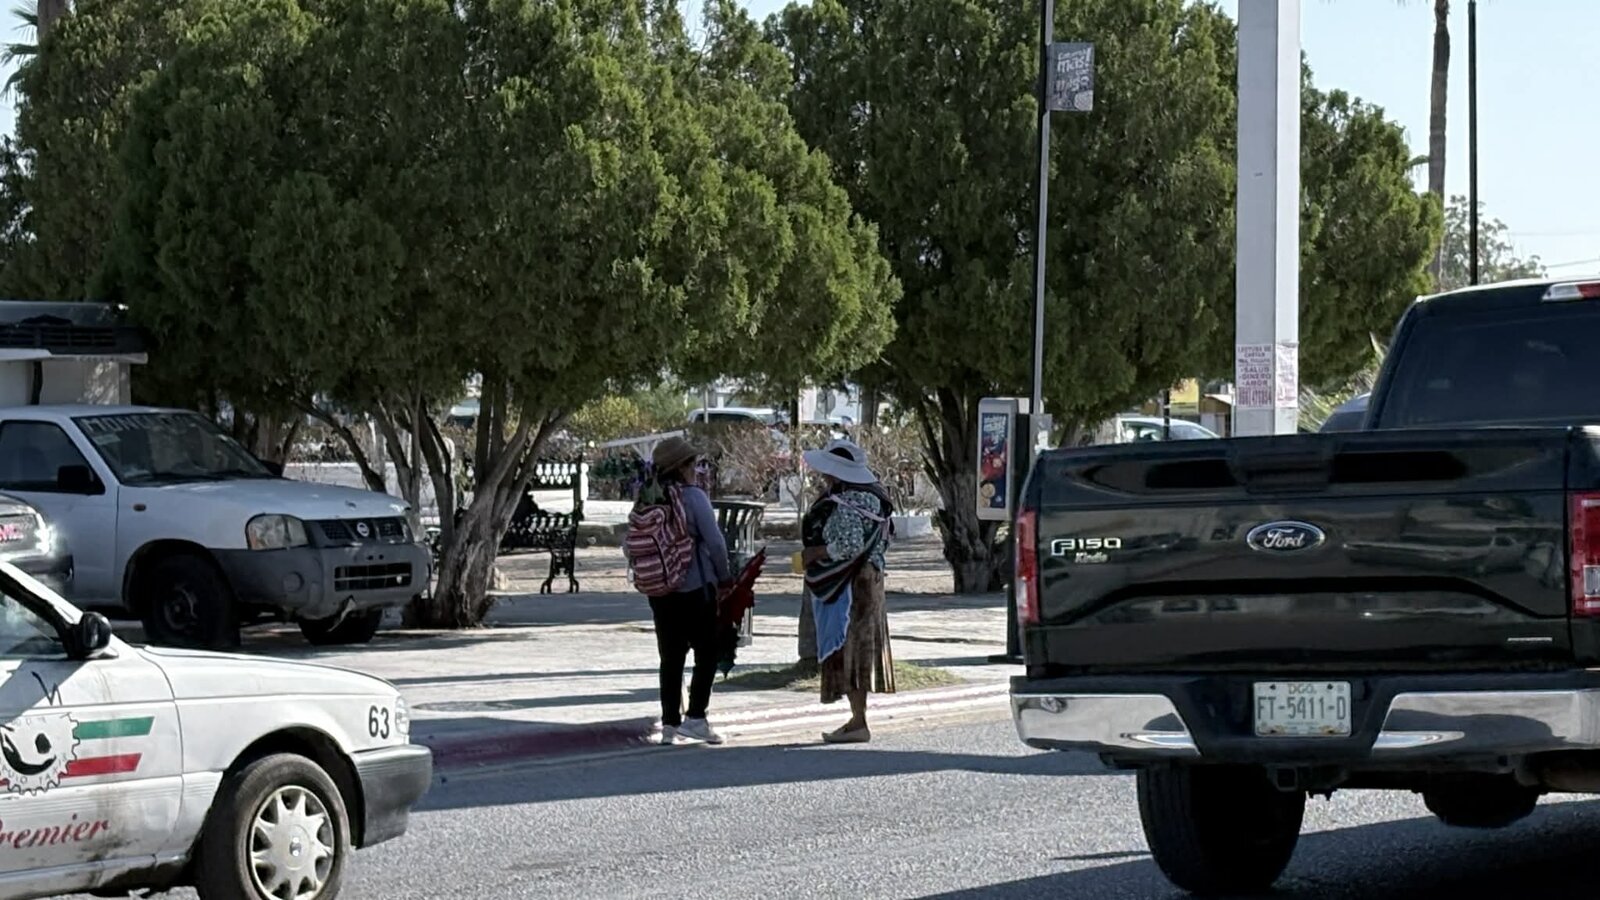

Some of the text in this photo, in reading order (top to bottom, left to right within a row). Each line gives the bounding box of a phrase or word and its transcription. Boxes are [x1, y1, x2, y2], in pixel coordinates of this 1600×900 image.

[1264, 529, 1305, 548] Ford
[1257, 696, 1347, 721] FT-5411-D
[368, 705, 390, 740] 63
